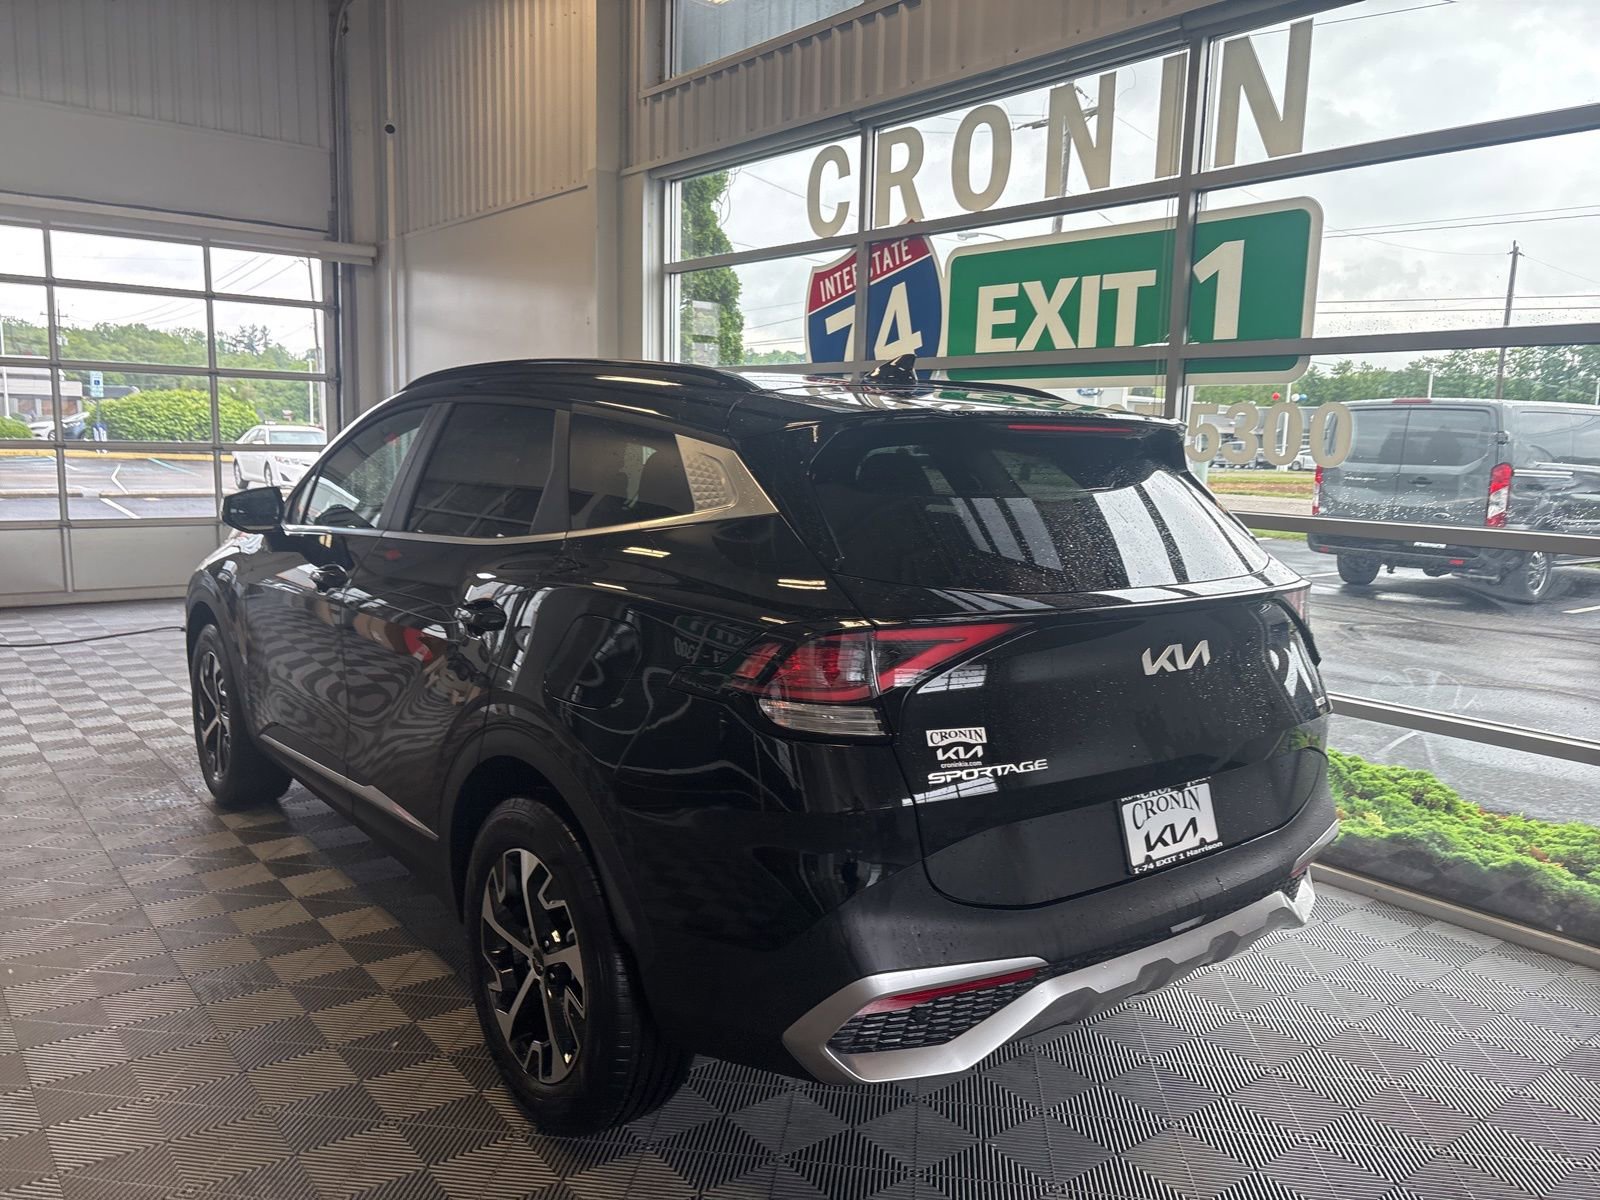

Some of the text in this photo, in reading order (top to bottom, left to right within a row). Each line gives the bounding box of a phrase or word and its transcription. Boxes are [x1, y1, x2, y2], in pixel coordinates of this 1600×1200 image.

[806, 18, 1314, 238] CRONIN
[820, 238, 913, 302] INTETATE
[975, 240, 1246, 354] EXIT 1
[825, 281, 923, 366] 74
[1141, 640, 1211, 676] KIA
[929, 728, 985, 745] CRONIN
[936, 745, 984, 761] KIA
[927, 758, 1049, 785] SPORTAGE
[940, 760, 983, 769] croninkia.com
[1132, 786, 1202, 830] CRONIN
[1144, 816, 1199, 853] KIA
[1155, 855, 1177, 867] EXIT
[1186, 841, 1224, 857] Harrison
